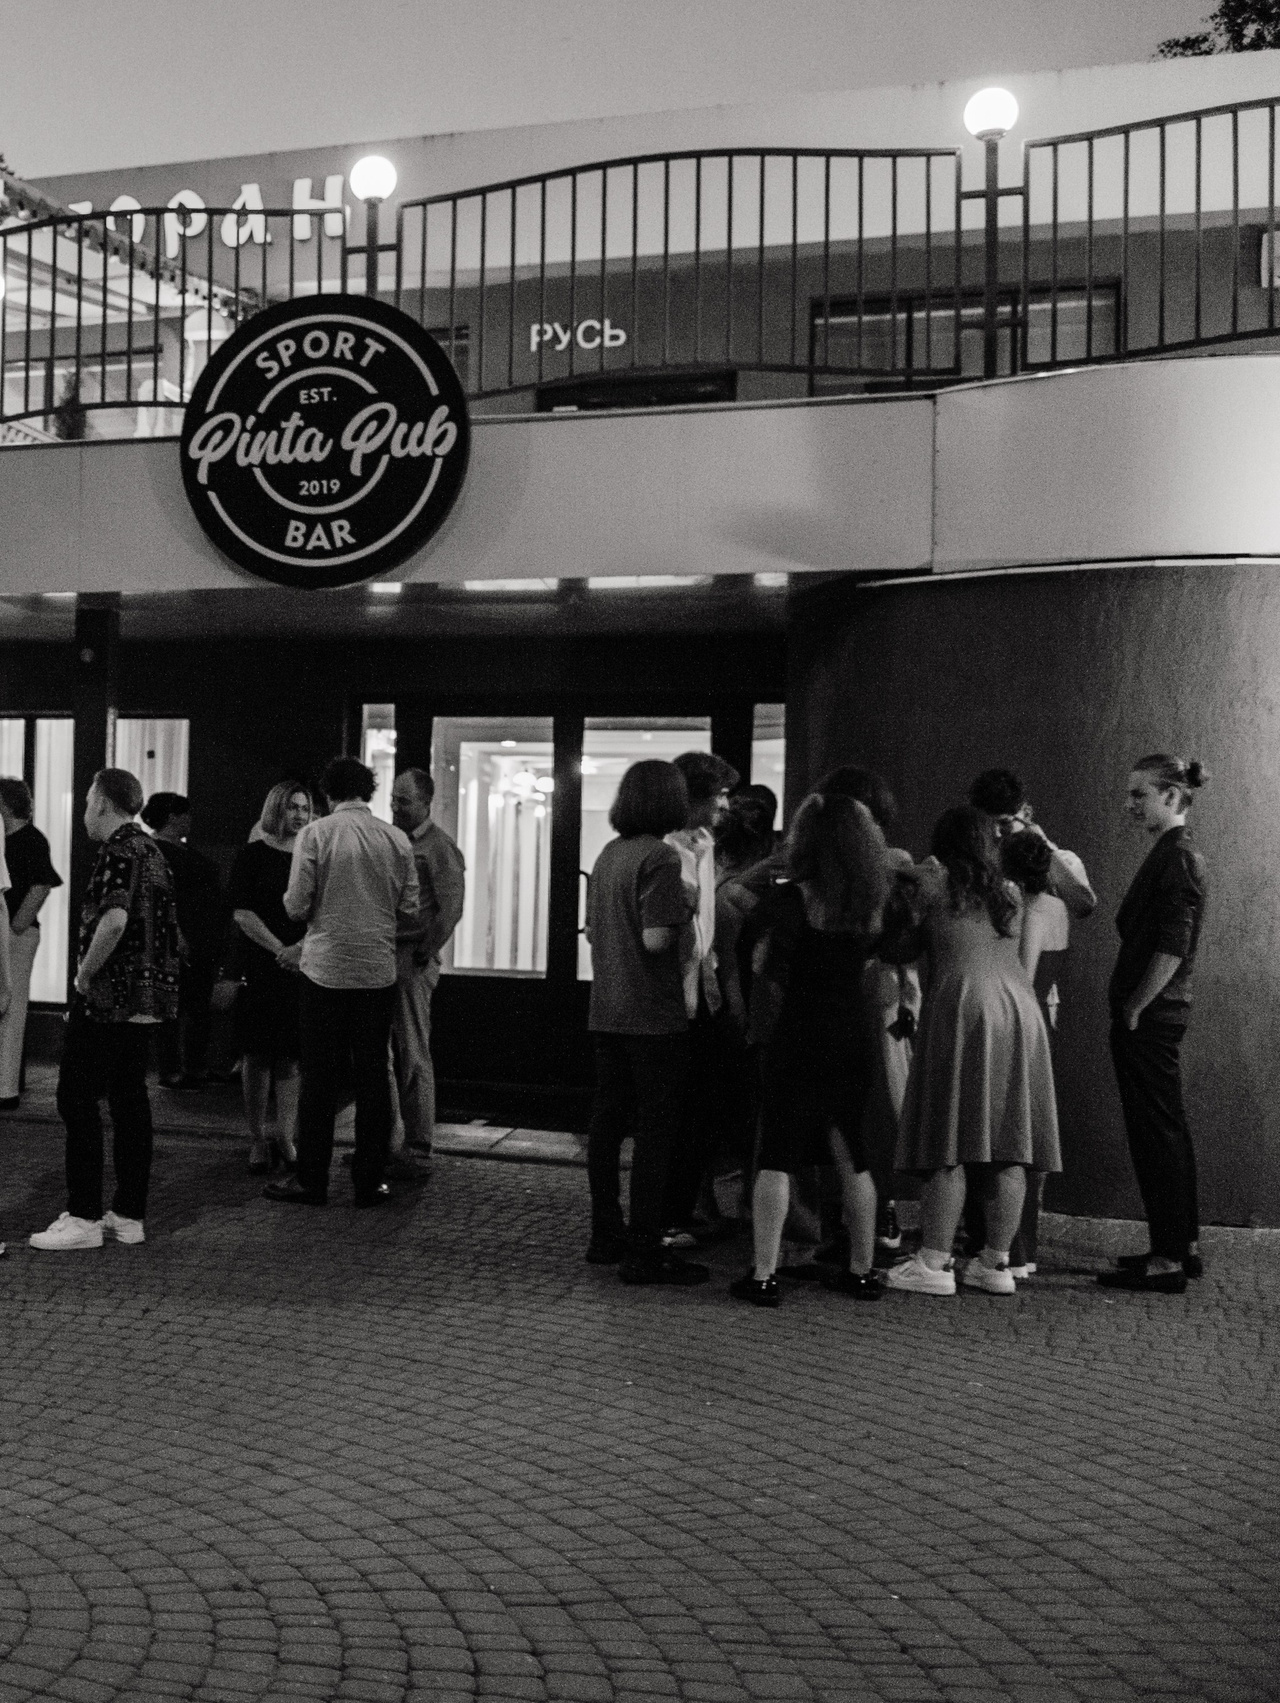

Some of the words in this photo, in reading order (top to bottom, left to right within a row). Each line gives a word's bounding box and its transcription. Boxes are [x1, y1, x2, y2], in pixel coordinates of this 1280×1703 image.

[530, 319, 627, 352] РУСЬ
[255, 330, 387, 380] SPORT
[299, 387, 338, 405] EST.
[188, 411, 334, 485] Pinta
[340, 402, 458, 477] Pub
[299, 479, 341, 496] 2019
[284, 519, 357, 551] BAR
